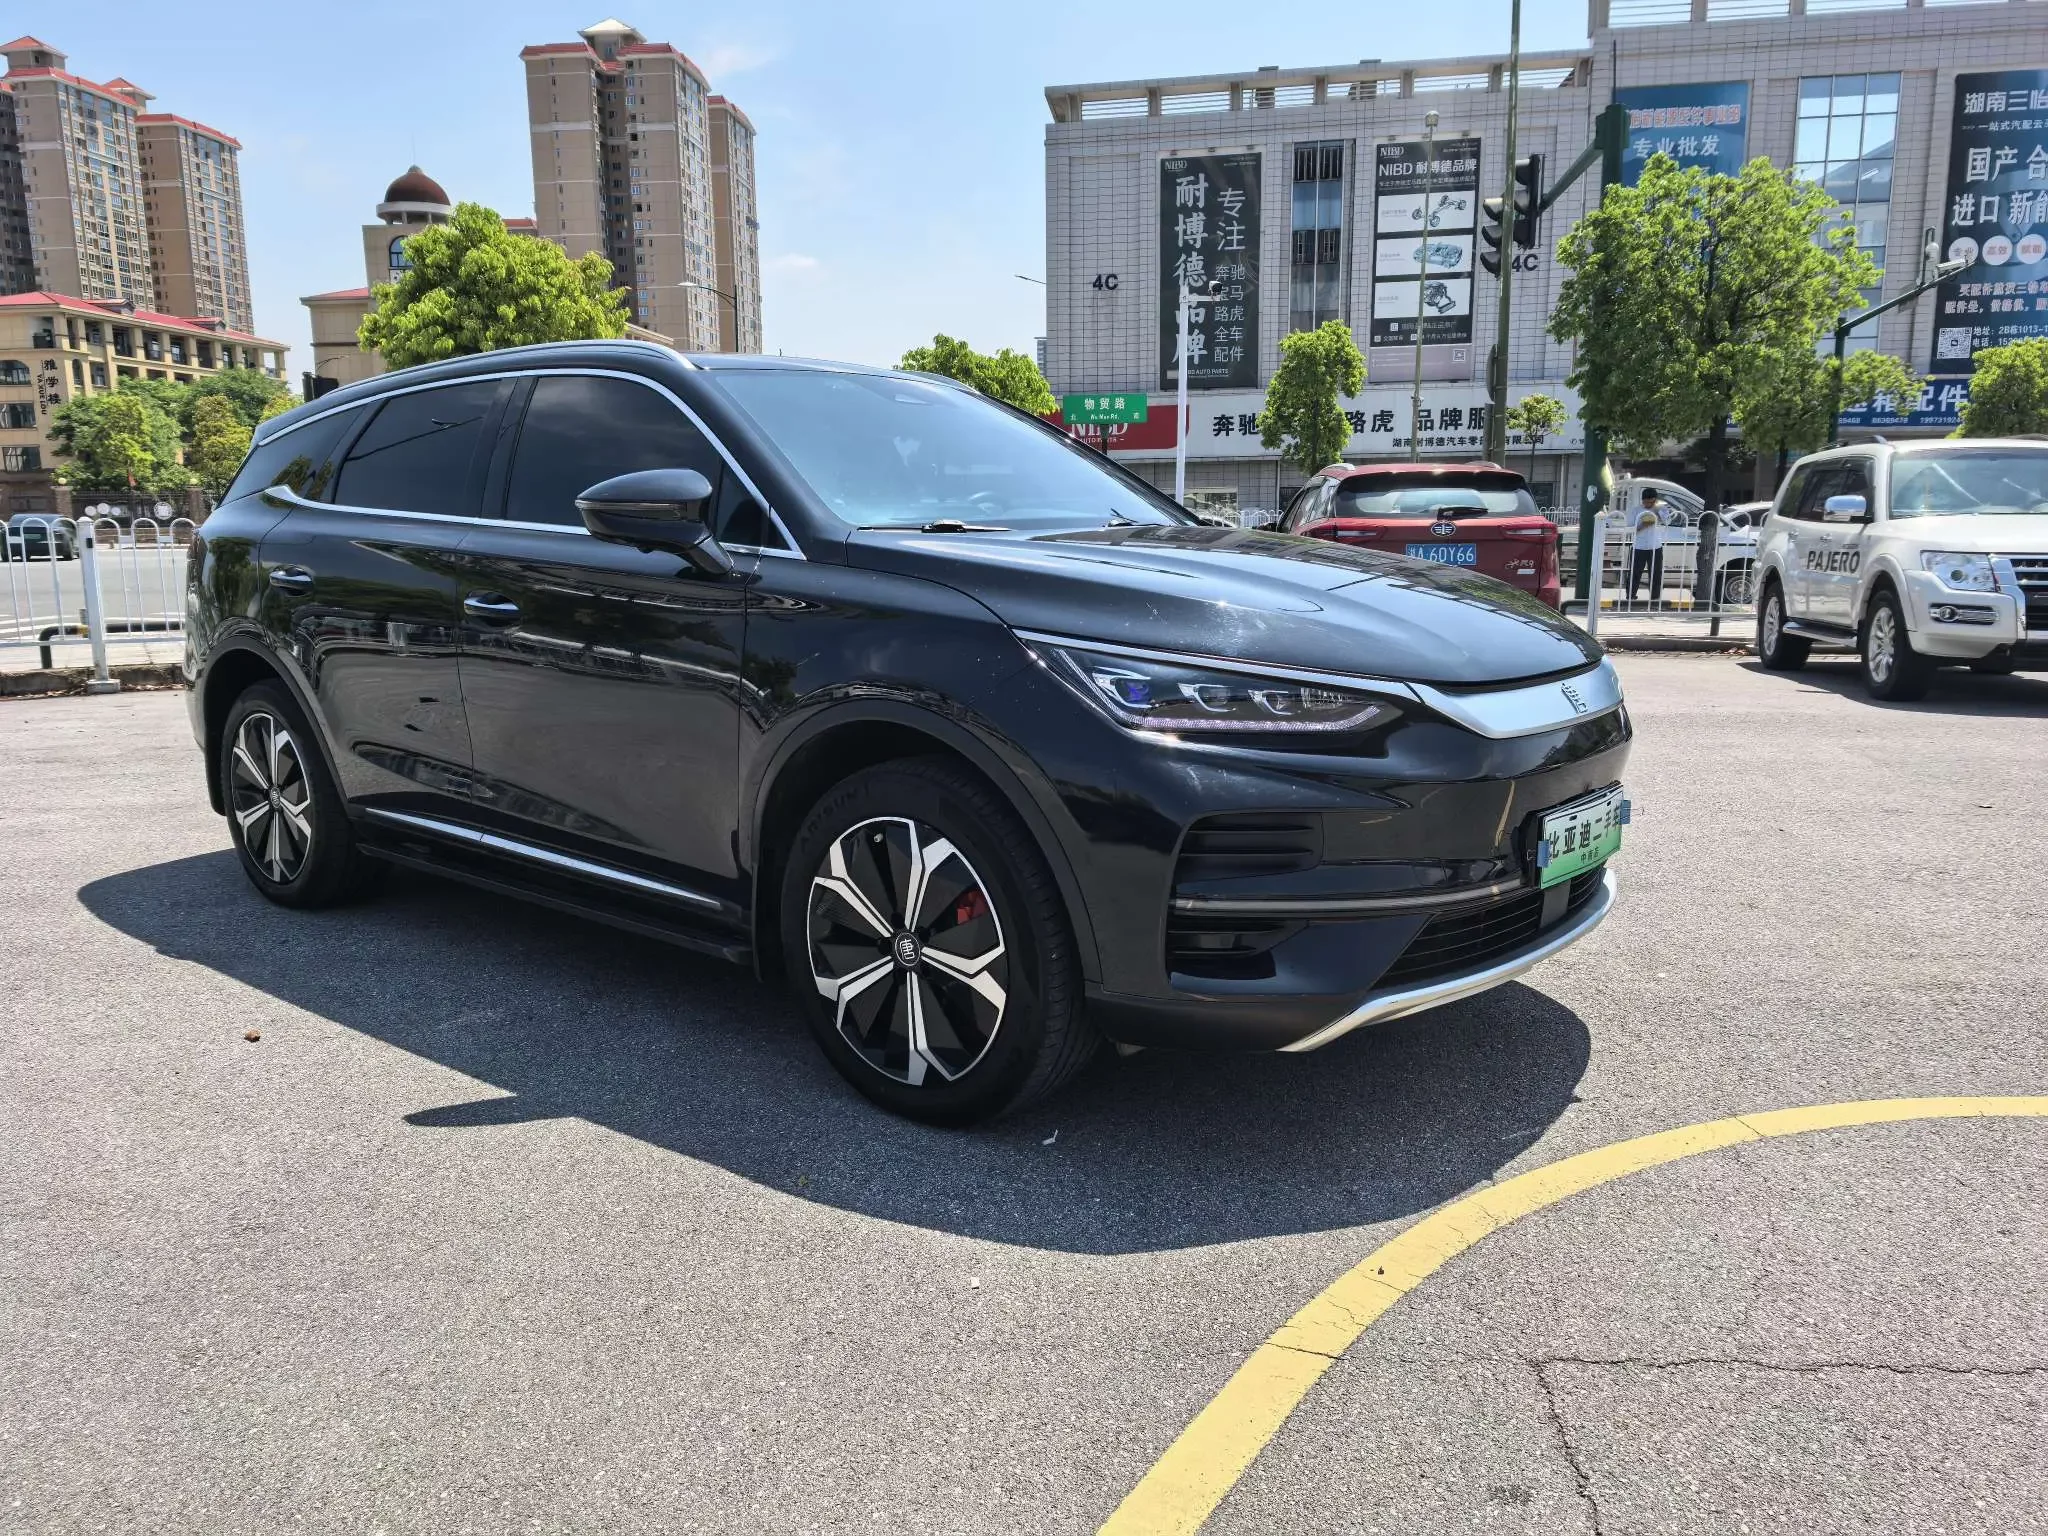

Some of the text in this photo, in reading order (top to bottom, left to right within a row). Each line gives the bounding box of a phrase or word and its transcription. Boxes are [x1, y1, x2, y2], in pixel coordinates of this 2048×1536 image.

[1633, 135, 1720, 158] 专业批发
[1379, 163, 1413, 177] NIBD
[1966, 146, 2018, 183] 国产
[1217, 187, 1246, 251] 专注
[1952, 193, 2000, 226] 进口
[1511, 253, 1538, 272] 4C
[1092, 273, 1119, 291] 4C
[1214, 345, 1245, 362] 配件
[1084, 397, 1126, 411] 物贸路
[1806, 550, 1861, 573] PAJERO
